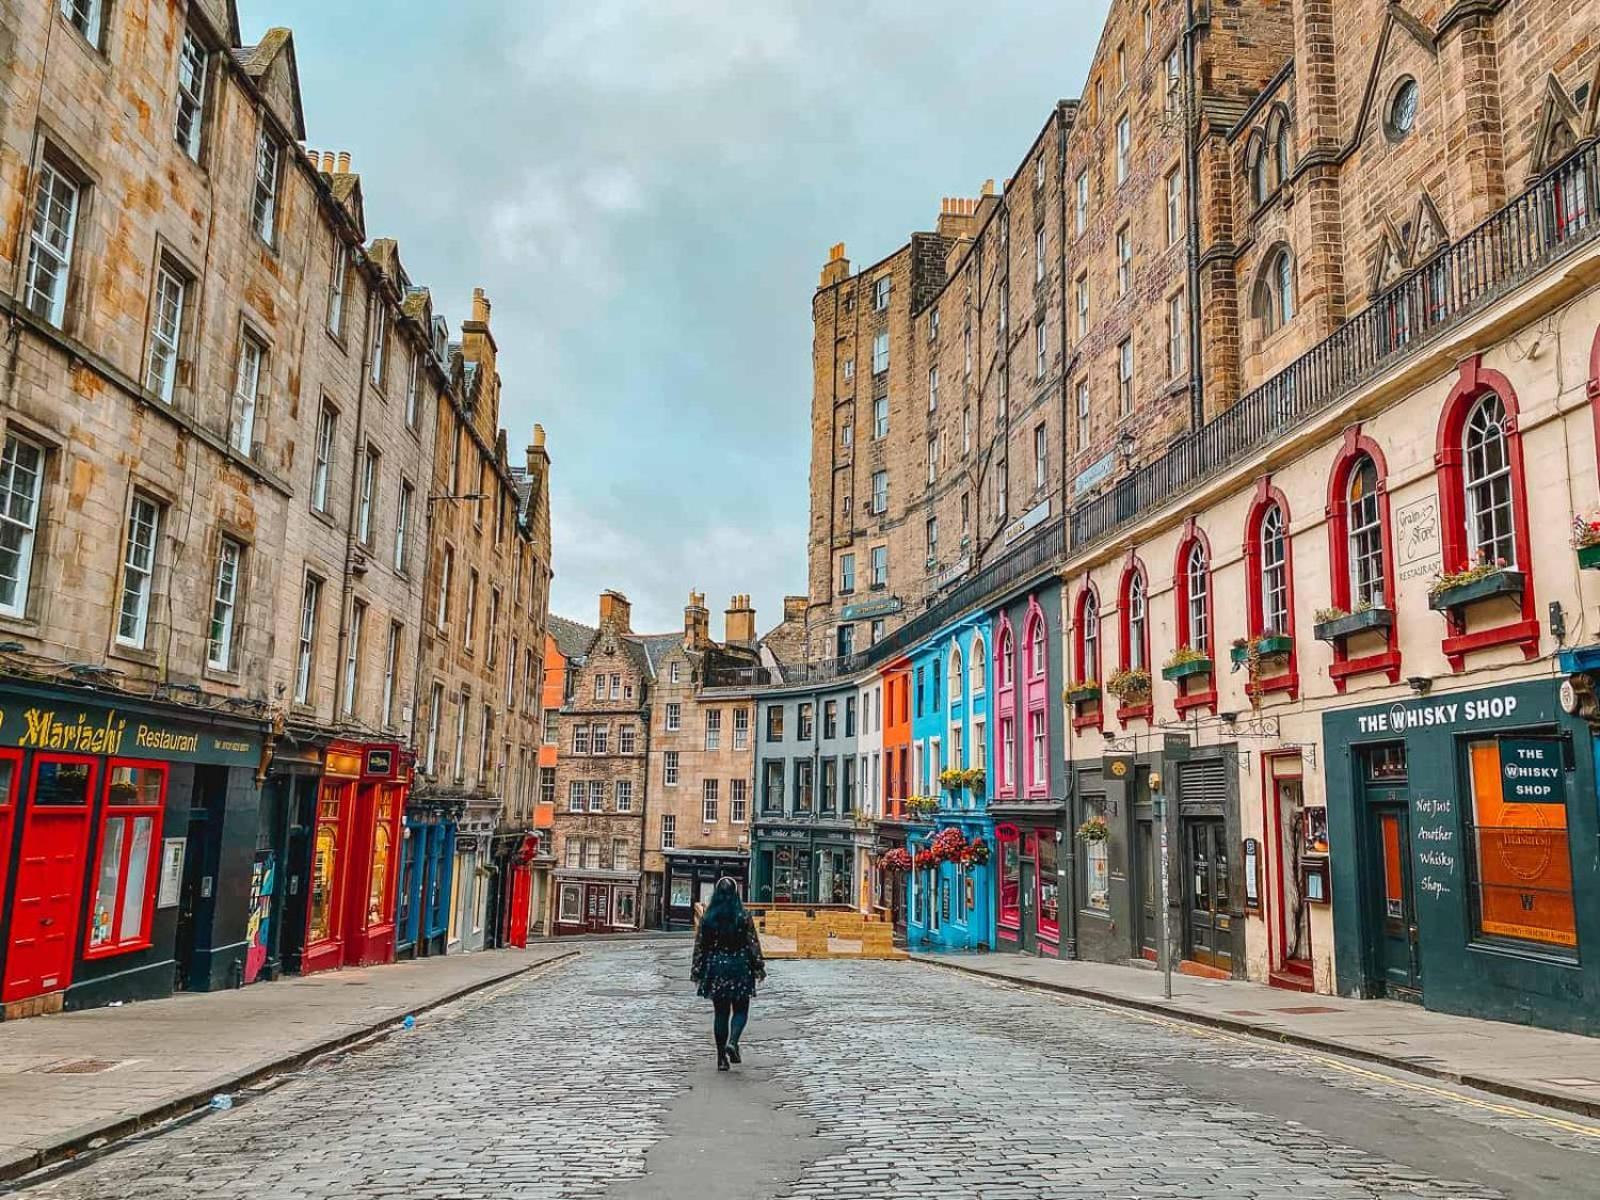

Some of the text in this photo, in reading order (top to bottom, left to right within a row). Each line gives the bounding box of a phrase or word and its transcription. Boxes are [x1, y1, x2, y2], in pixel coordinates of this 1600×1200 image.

[1358, 696, 1517, 733] THE WHISKY SHOP
[18, 708, 126, 754] Mariachi
[136, 724, 198, 752] Restaurant
[1517, 749, 1544, 759] THE
[1505, 765, 1558, 778] WHISKY
[1516, 785, 1551, 795] SHOP
[1417, 799, 1451, 818] Not Just
[1418, 825, 1453, 840] Another
[1420, 850, 1454, 875] Whisky
[1421, 875, 1451, 900] Shop...
